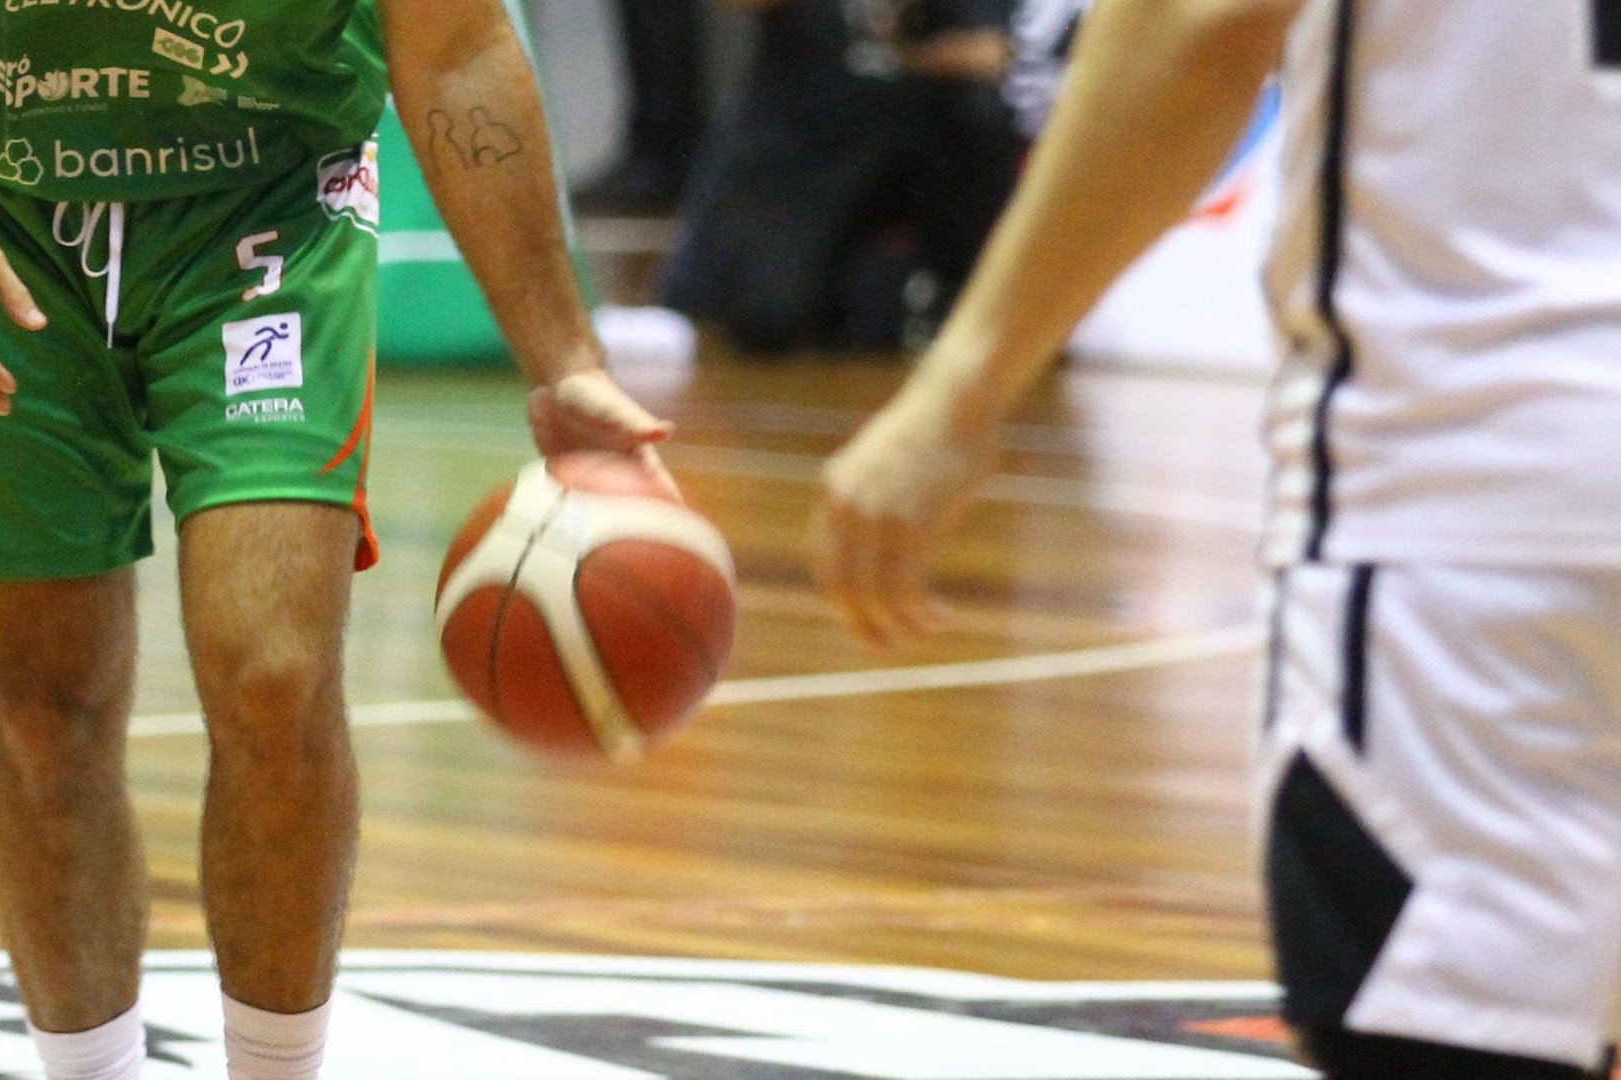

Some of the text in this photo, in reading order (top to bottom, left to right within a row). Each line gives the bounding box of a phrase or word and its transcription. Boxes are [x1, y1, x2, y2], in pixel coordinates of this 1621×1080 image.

[55, 127, 260, 178] banrisul
[235, 230, 284, 301] 5
[226, 398, 303, 419] CATERA
